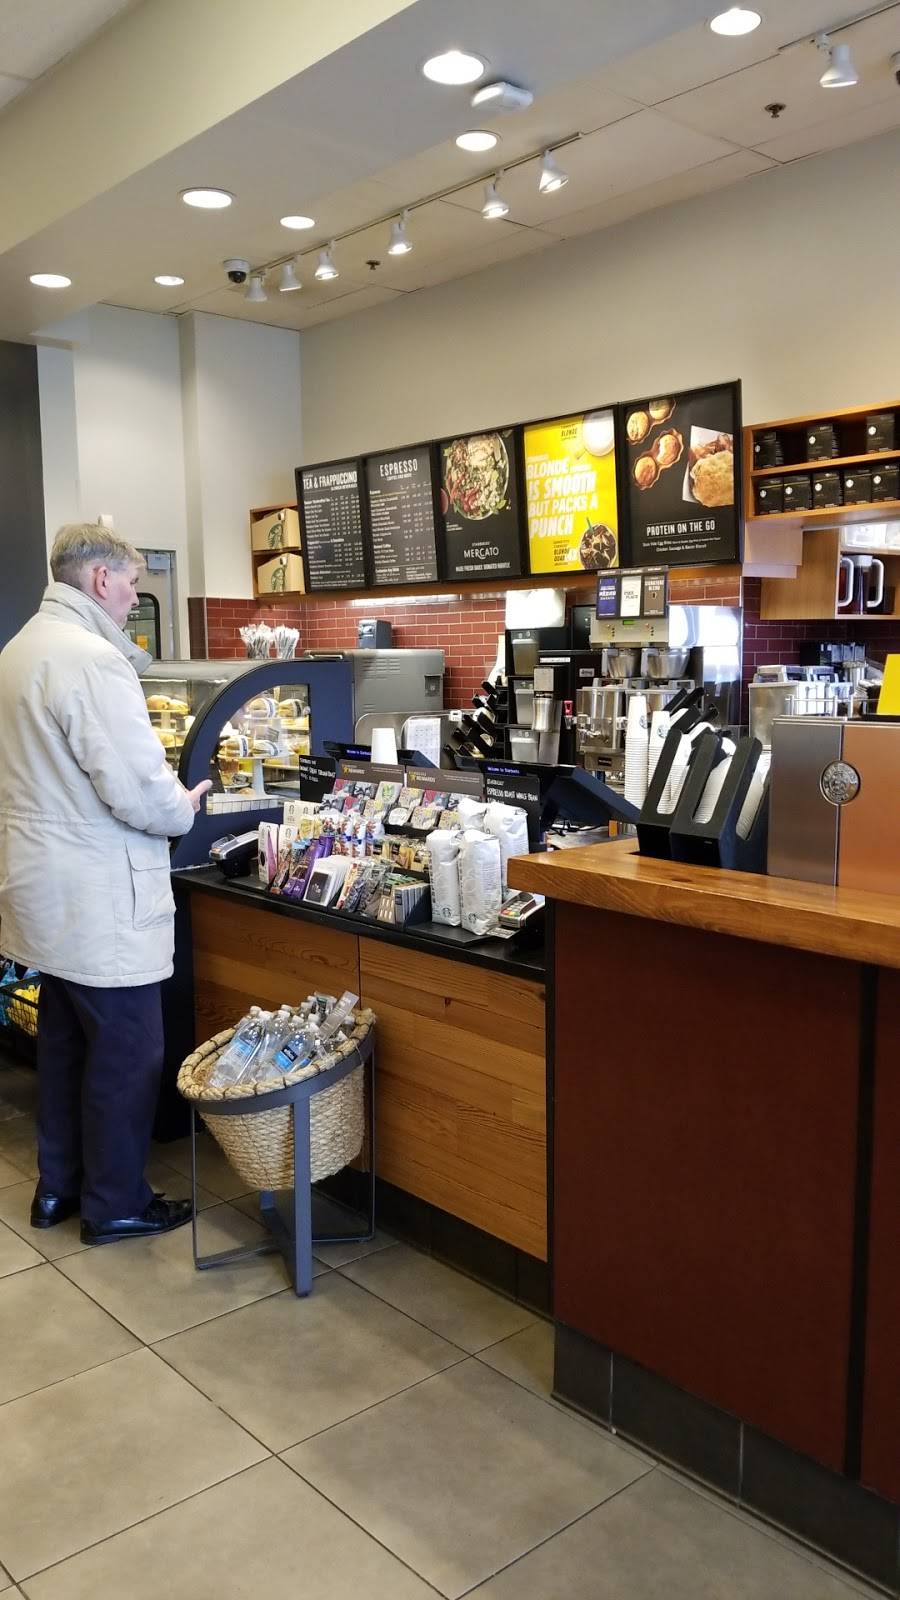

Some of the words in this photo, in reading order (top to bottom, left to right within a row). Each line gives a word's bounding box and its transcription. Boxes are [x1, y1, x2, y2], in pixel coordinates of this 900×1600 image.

[379, 458, 418, 477] ESPRESSO
[527, 459, 570, 479] BLONDE
[303, 477, 313, 490] TEA
[313, 476, 319, 489] &
[319, 471, 358, 488] FRAPPUCCINO
[528, 479, 540, 500] IS
[544, 471, 597, 499] SMOOTH
[528, 499, 550, 518] BUT
[552, 495, 587, 515] PACKS
[590, 493, 599, 510] A
[529, 514, 574, 539] PUNCH
[646, 524, 675, 536] PROTEIN
[677, 522, 688, 534] ON
[689, 520, 703, 532] THE
[705, 519, 716, 531] GO
[463, 546, 500, 560] MERCATO
